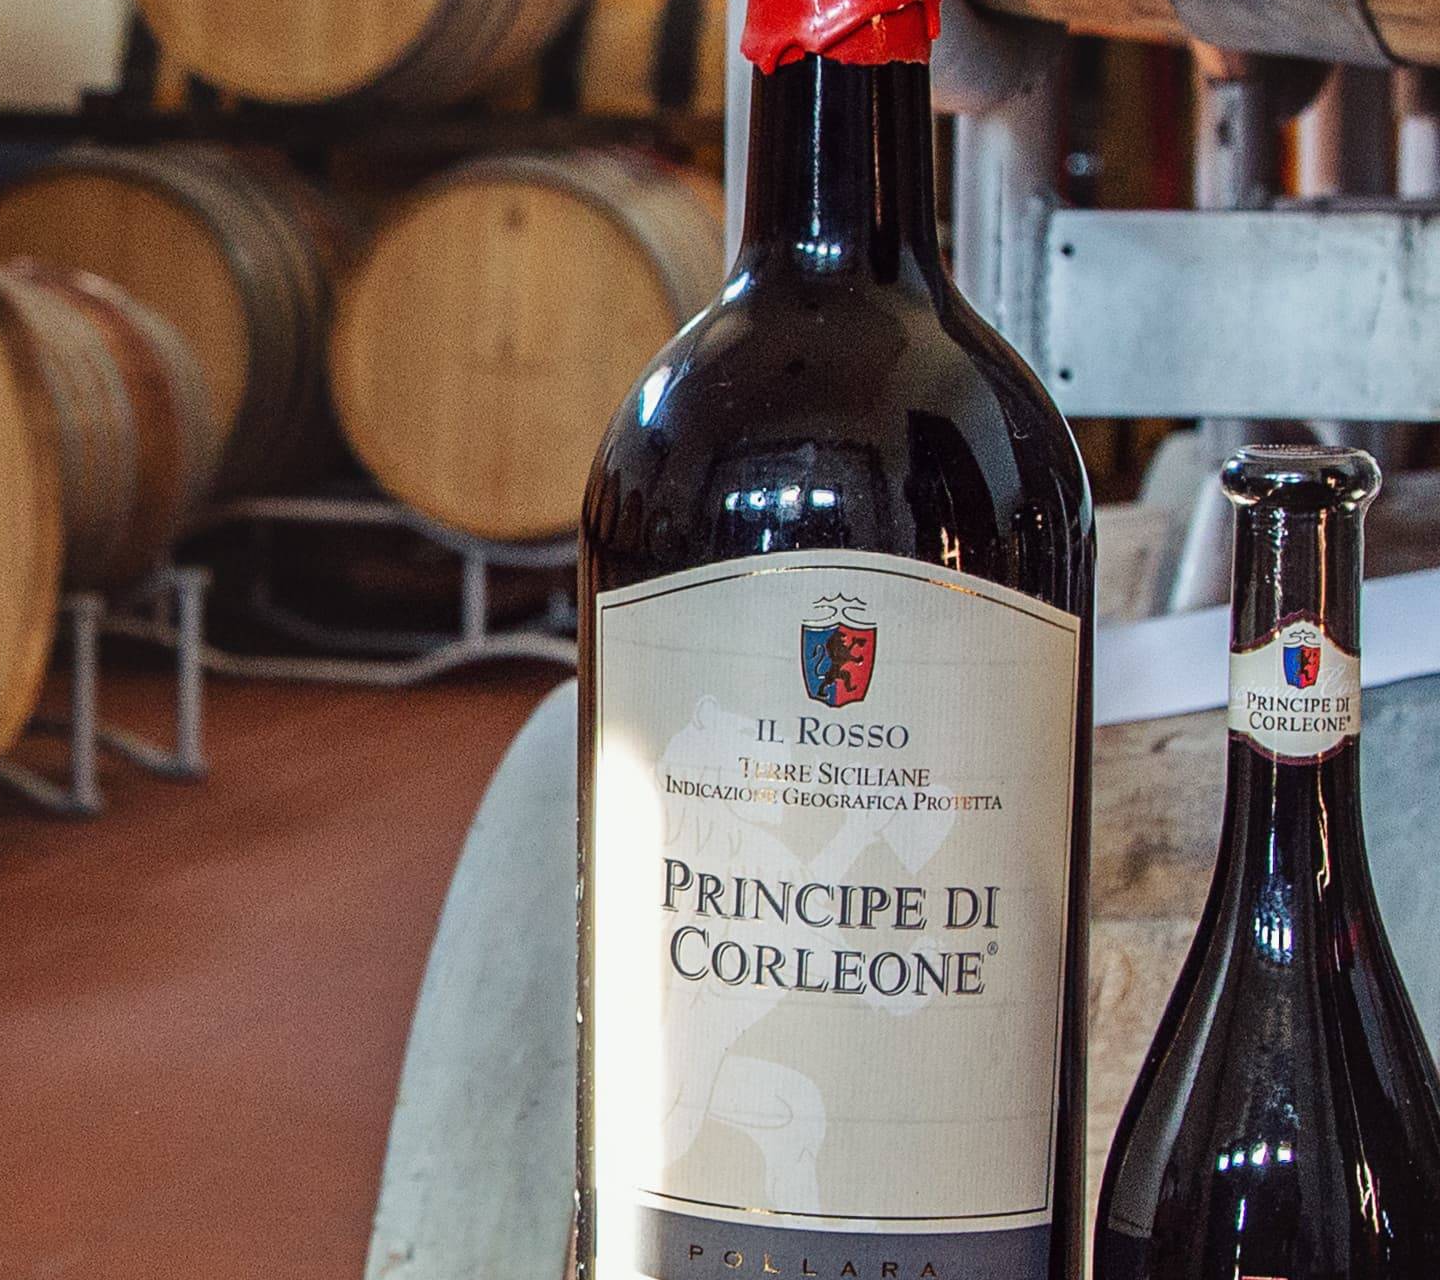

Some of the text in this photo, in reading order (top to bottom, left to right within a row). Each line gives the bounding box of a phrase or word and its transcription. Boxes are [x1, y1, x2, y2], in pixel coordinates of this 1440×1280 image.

[1246, 691, 1350, 713] PRINCIPE DI
[755, 716, 910, 749] IL ROSSO
[818, 762, 931, 788] SICILIANE
[782, 788, 909, 811] GEOGRAFICA
[912, 791, 1004, 812] PROTETTA
[660, 856, 1001, 931] PRINCIPE DI
[687, 1243, 940, 1280] POLLARA
